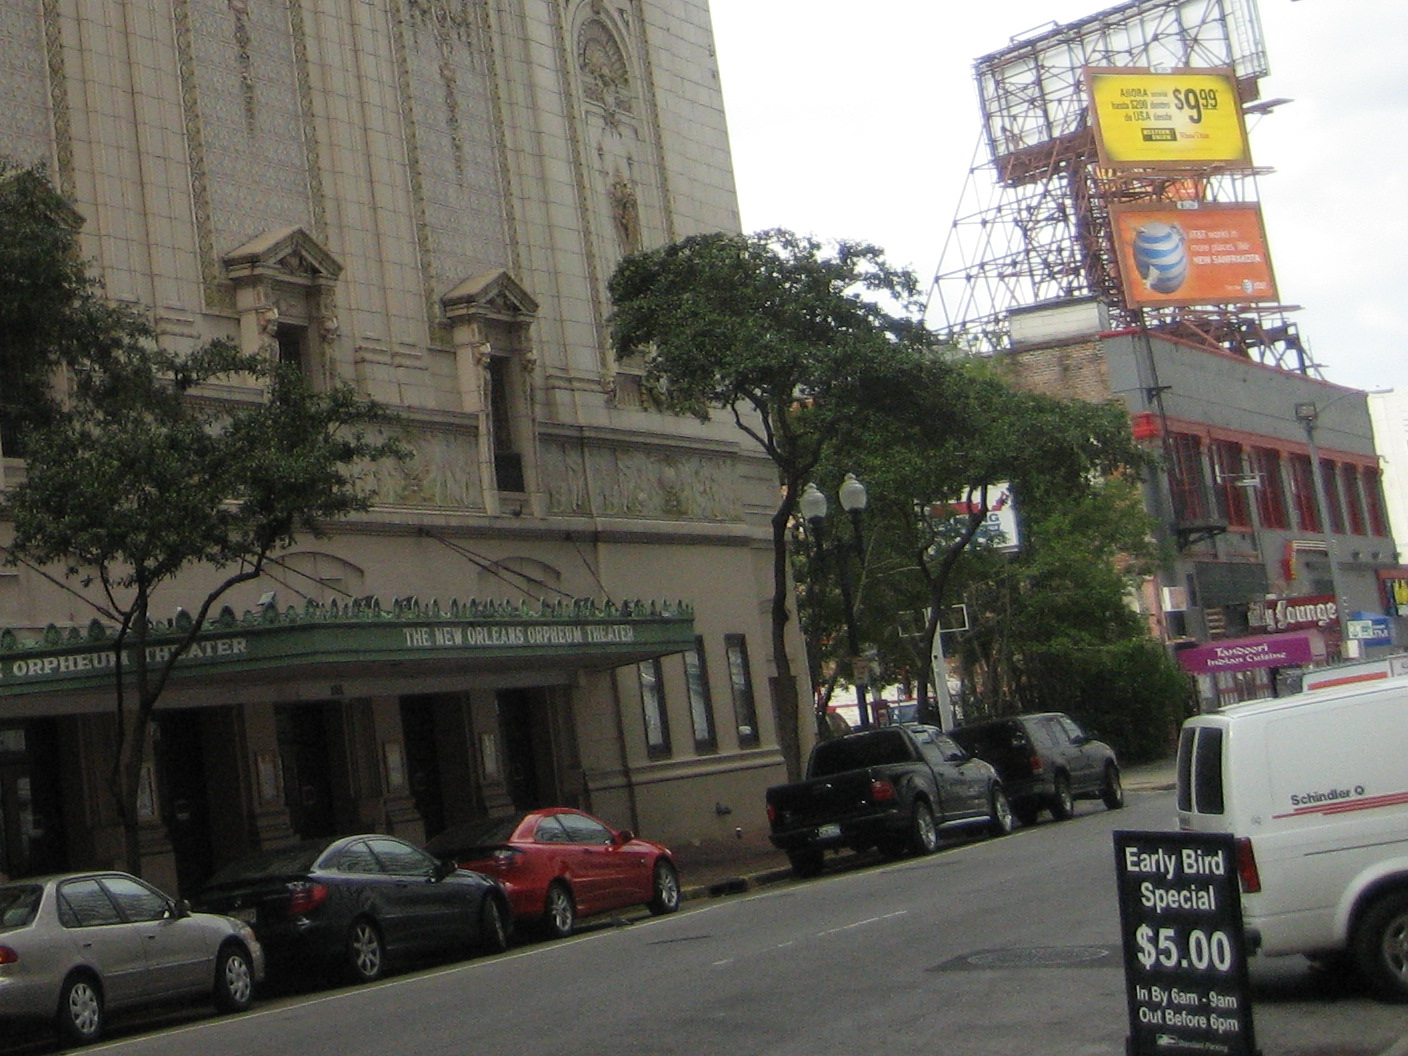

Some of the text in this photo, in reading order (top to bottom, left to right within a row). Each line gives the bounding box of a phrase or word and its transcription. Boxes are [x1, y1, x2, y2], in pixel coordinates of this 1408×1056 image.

[1133, 110, 1151, 122] USA
[1275, 600, 1338, 629] Lounge
[402, 624, 634, 647] THE NEW ORLEANS ORPHEUM THEATER
[12, 649, 130, 677] ORPHEUM
[1207, 652, 1286, 666] Indian Cuisine
[1215, 644, 1268, 657] Tandoori
[1290, 788, 1352, 806] Schindler
[1124, 846, 1224, 879] Early Bird
[1140, 881, 1215, 914] Special
[1135, 923, 1231, 972] $5.00
[1136, 985, 1148, 1001] In
[1152, 986, 1168, 1006] By
[1171, 988, 1199, 1005] 6am
[1209, 991, 1238, 1009] 9am
[1139, 1007, 1240, 1034] Out Before 6pm
